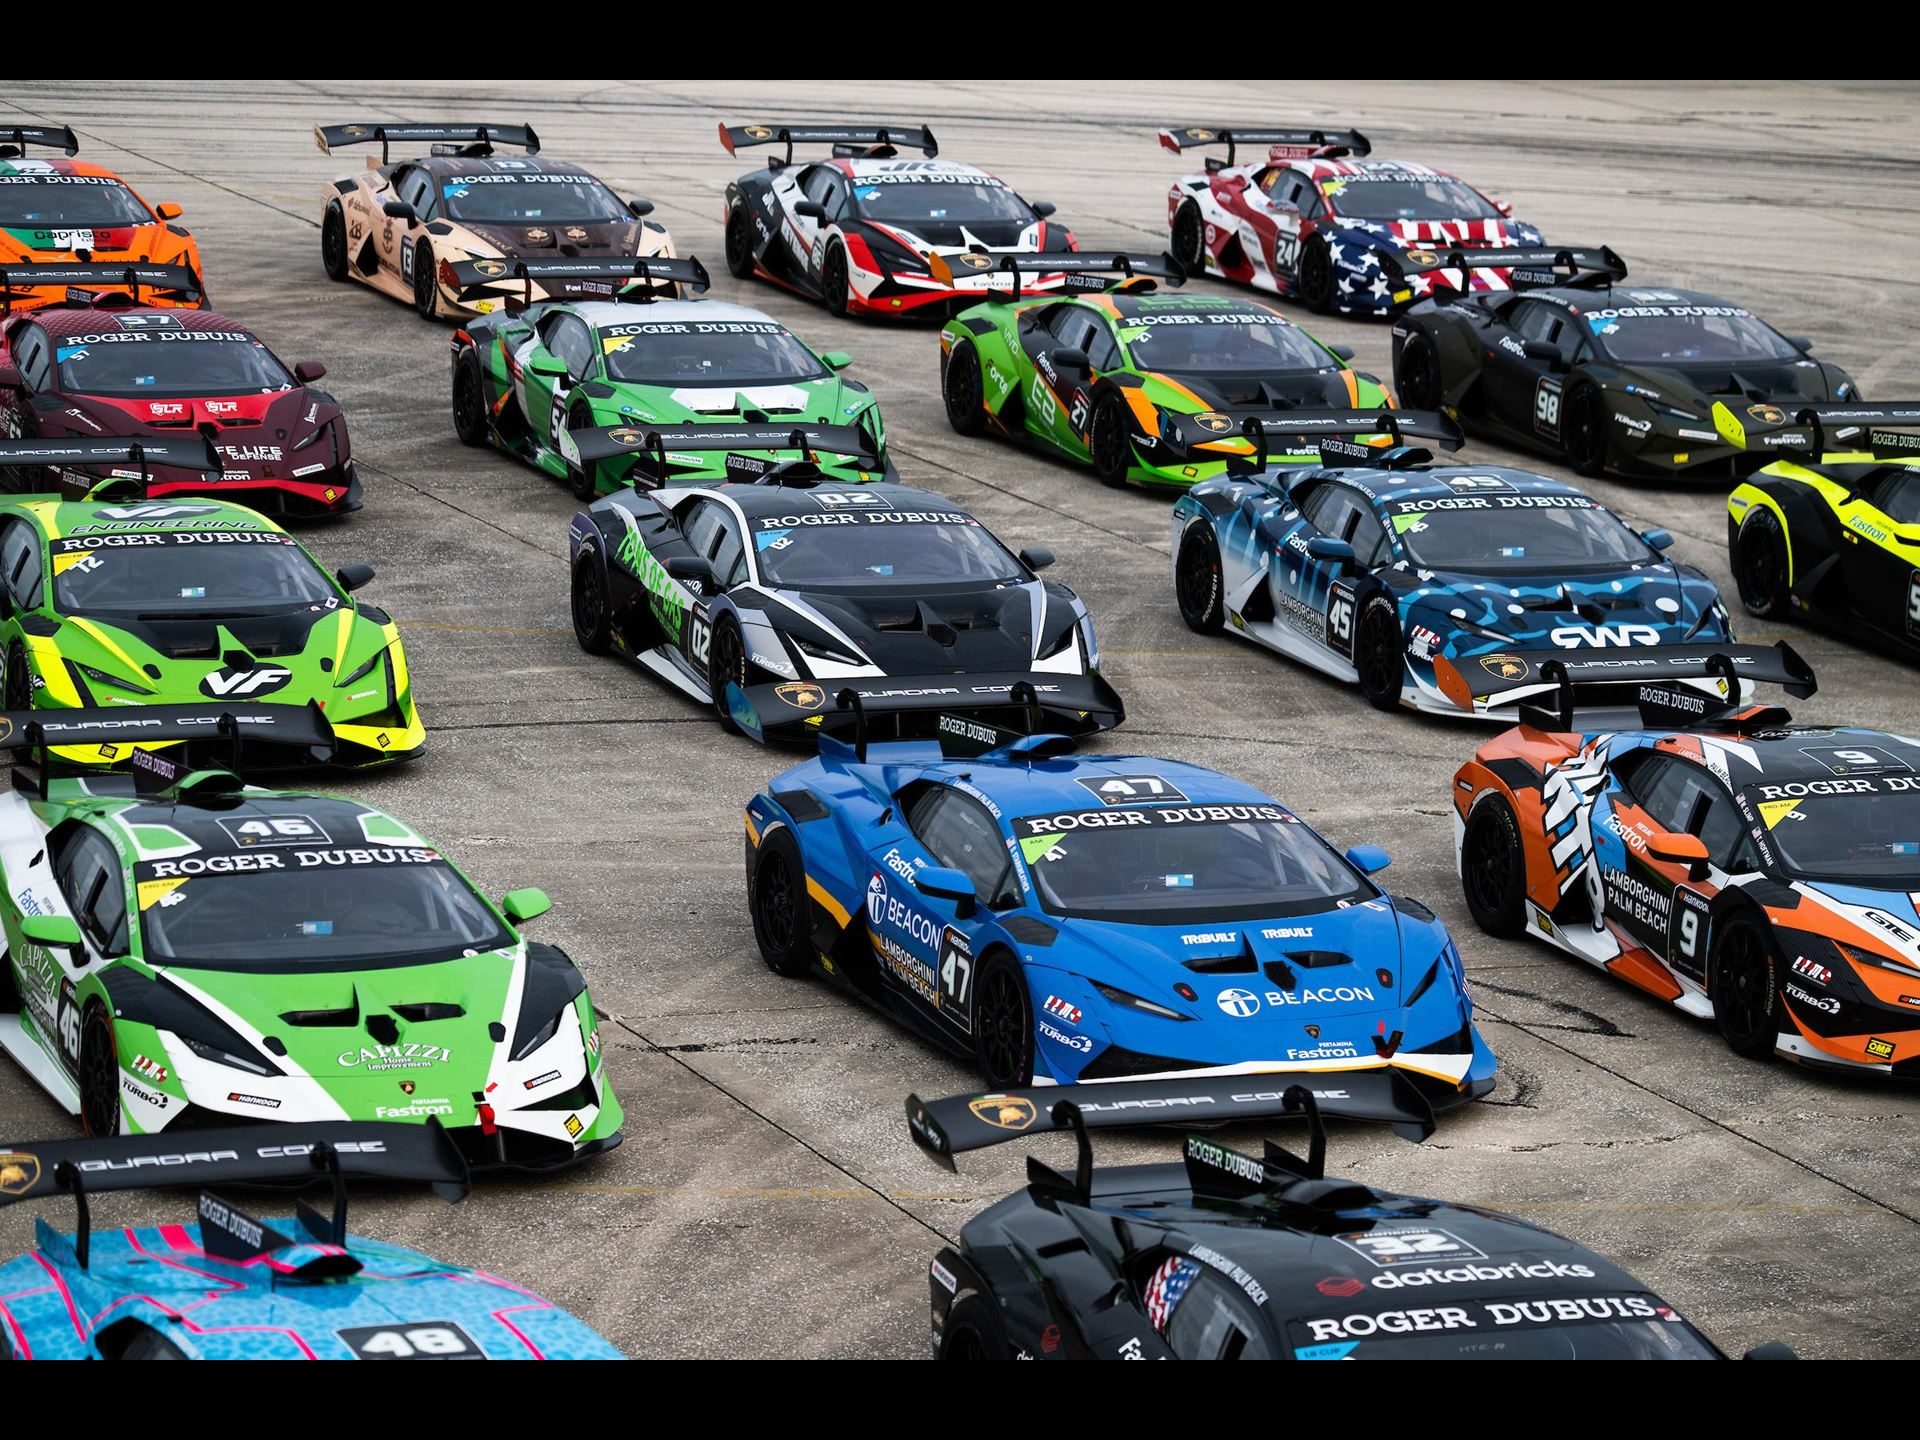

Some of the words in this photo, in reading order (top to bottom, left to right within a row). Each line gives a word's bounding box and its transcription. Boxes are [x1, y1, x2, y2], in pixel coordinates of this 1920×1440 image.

[44, 177, 118, 186] DUBUIS
[451, 175, 517, 184] ROGER
[522, 175, 592, 184] DUBUIS
[853, 175, 926, 186] ROGER
[930, 174, 1001, 186] DUBUIS
[1331, 174, 1389, 183] ROGER
[1277, 240, 1294, 264] 24
[1066, 275, 1084, 287] ROGER
[1085, 277, 1105, 289] DUBUIS
[1512, 271, 1532, 283] ROGER
[1533, 274, 1556, 285] DUBUIS
[582, 281, 597, 292] ROGER
[597, 284, 613, 295] DUBUIS
[119, 315, 170, 325] 57
[1126, 315, 1202, 326] ROGER
[1207, 315, 1286, 325] DUBUIS
[1584, 308, 1668, 320] ROGER
[1670, 306, 1750, 317] DUBUIS
[67, 333, 151, 346] ROGER
[158, 331, 247, 342] DUBUIS
[610, 325, 690, 336] ROGER
[696, 324, 779, 334] DUBUIS
[70, 350, 91, 361] 57
[1037, 351, 1058, 382] Fastron
[1537, 389, 1560, 424] 98
[1071, 403, 1087, 430] 27
[1764, 435, 1806, 445] Fastron
[1872, 432, 1897, 446] ROGER
[231, 453, 283, 461] DEFENSE
[242, 446, 283, 455] LIFE
[1321, 438, 1345, 454] ROGER
[1345, 442, 1369, 459] DUBUIS
[727, 456, 744, 470] ROGER
[745, 459, 764, 474] DUBUIS
[1448, 475, 1505, 487] 45
[816, 492, 879, 504] 02
[1398, 497, 1488, 513] ROGER
[1496, 497, 1592, 508] DUBUIS
[69, 520, 261, 535] ENGINEERING
[761, 514, 863, 529] ROGER
[865, 512, 966, 525] DUBUIS
[1848, 514, 1887, 542] Fastron
[61, 534, 165, 550] ROGER
[173, 532, 281, 545] DUBUIS
[768, 537, 794, 550] 02
[1279, 591, 1325, 626] LAMBORGHINI
[1329, 599, 1351, 640] 45
[691, 618, 711, 665] 02
[204, 669, 292, 695] VF
[1640, 686, 1670, 707] ROGER
[1671, 691, 1705, 714] DUBUIS
[939, 716, 966, 737] ROGER
[967, 722, 997, 744] DUBUIS
[132, 750, 153, 771] ROGER
[153, 757, 175, 779] DUBUIS
[1833, 750, 1878, 764] 9
[1099, 778, 1165, 795] 47
[1759, 778, 1879, 799] ROGER
[1026, 810, 1151, 833] ROGER
[1157, 806, 1284, 823] DUBUIS
[1787, 810, 1807, 821] 9
[236, 819, 315, 837] 46
[151, 854, 285, 877] ROGER
[294, 848, 432, 867] DUBUIS
[1603, 862, 1671, 915] LAMBORGHINI
[1608, 885, 1634, 916] PALM
[1634, 901, 1668, 935] BEACH
[887, 896, 942, 952] BEACON
[1260, 927, 1313, 939] TRIBUILT
[1680, 908, 1699, 958] 9
[1180, 931, 1237, 945] TRIBUILT
[879, 931, 936, 988] LAMBORGHINI
[940, 949, 971, 1005] 47
[907, 971, 936, 1008] BEACH
[1264, 987, 1375, 1007] BEACON
[1785, 984, 1830, 1012] TURBO
[59, 1000, 80, 1061] 46
[1038, 1023, 1082, 1050] TURBO
[336, 1043, 453, 1068] CAPIZZI
[1286, 1047, 1358, 1060] Fastron
[1867, 1041, 1892, 1055] OMP
[366, 1061, 433, 1071] Improvement
[381, 1056, 413, 1064] Home
[122, 1078, 160, 1106] TURBO
[375, 1104, 453, 1118] Fastron
[1188, 1138, 1224, 1170] ROGER
[1225, 1152, 1265, 1184] DUBUIS
[199, 1196, 230, 1230] ROGER
[229, 1213, 263, 1248] DUBUIS
[1355, 1236, 1461, 1256] 32
[1187, 1243, 1233, 1277] LAMBORGHINI
[1229, 1262, 1250, 1287] PALM
[1245, 1276, 1269, 1307] BEACH
[1371, 1260, 1596, 1291] databricks
[1306, 1308, 1476, 1341] ROGER
[1485, 1297, 1658, 1325] DUBUIS
[360, 1328, 468, 1358] 48
[1319, 1347, 1341, 1358] CUP
